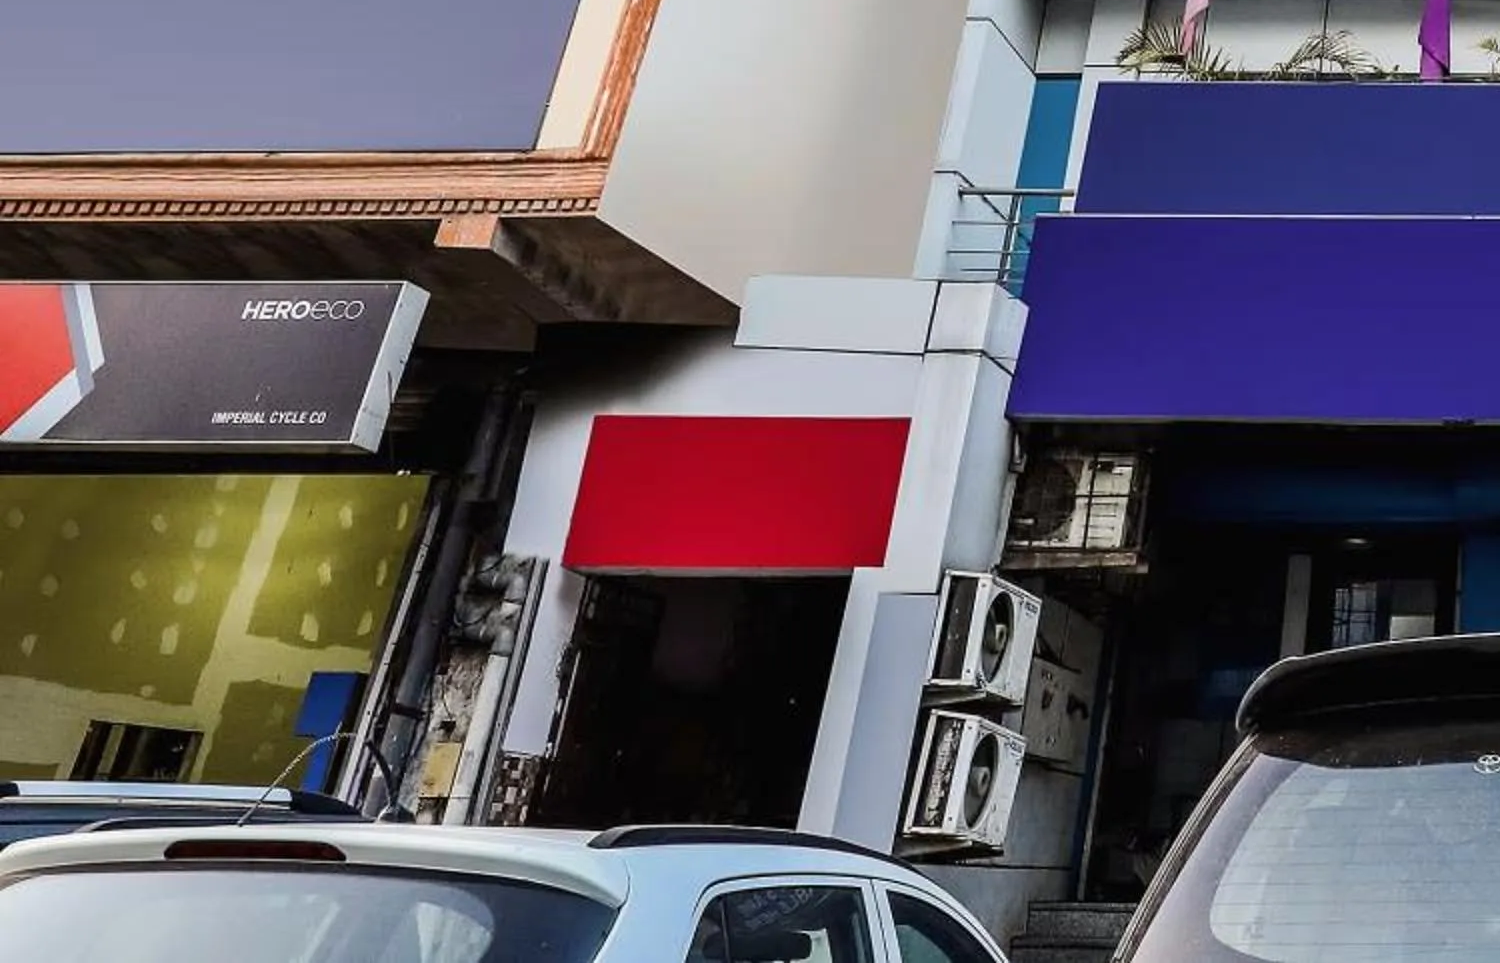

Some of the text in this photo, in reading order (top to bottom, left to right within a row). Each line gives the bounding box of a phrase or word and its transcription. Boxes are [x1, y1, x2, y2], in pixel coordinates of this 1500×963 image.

[211, 411, 327, 424] IMPERIAL CYCLE CO
